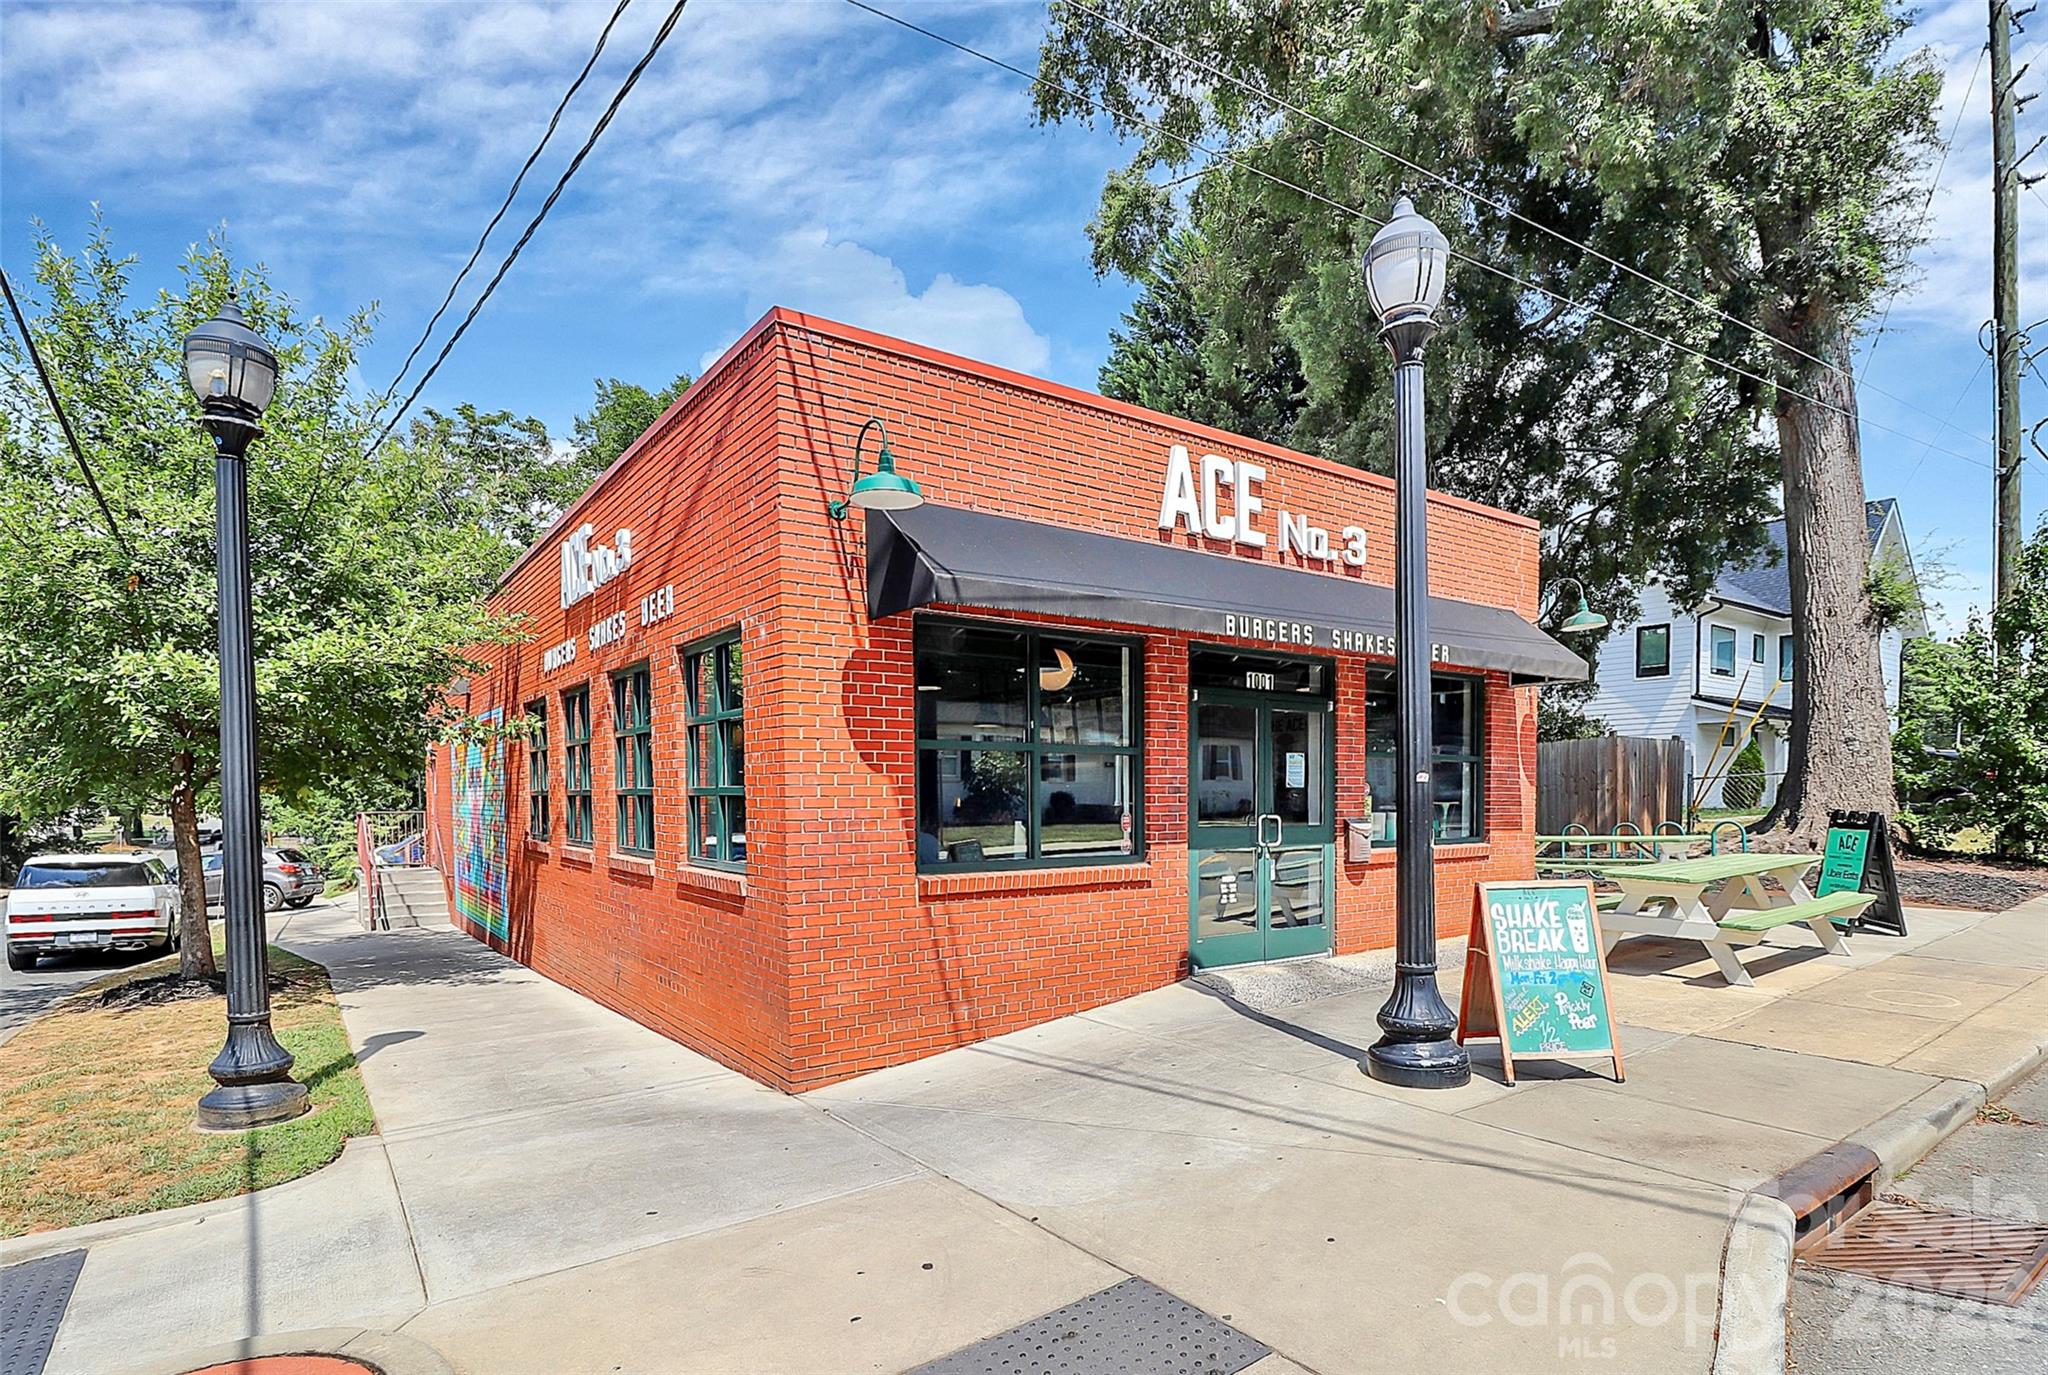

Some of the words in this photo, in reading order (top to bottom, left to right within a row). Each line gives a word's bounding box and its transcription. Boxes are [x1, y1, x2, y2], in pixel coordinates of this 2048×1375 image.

[1158, 444, 1266, 548] ACE
[1225, 614, 1314, 646] BURGERS
[1332, 629, 1396, 655] SHAKES
[1431, 643, 1450, 663] ER
[1246, 671, 1275, 691] 1001
[1838, 834, 1859, 852] ACE
[1826, 868, 1842, 878] Uber
[1843, 870, 1859, 880] Eats
[1491, 896, 1563, 931] SHAKE
[1496, 927, 1568, 954] BREAK
[1502, 954, 1552, 971] Milkshake
[1512, 995, 1548, 1032] ALERT
[1554, 991, 1591, 1016] Prickly
